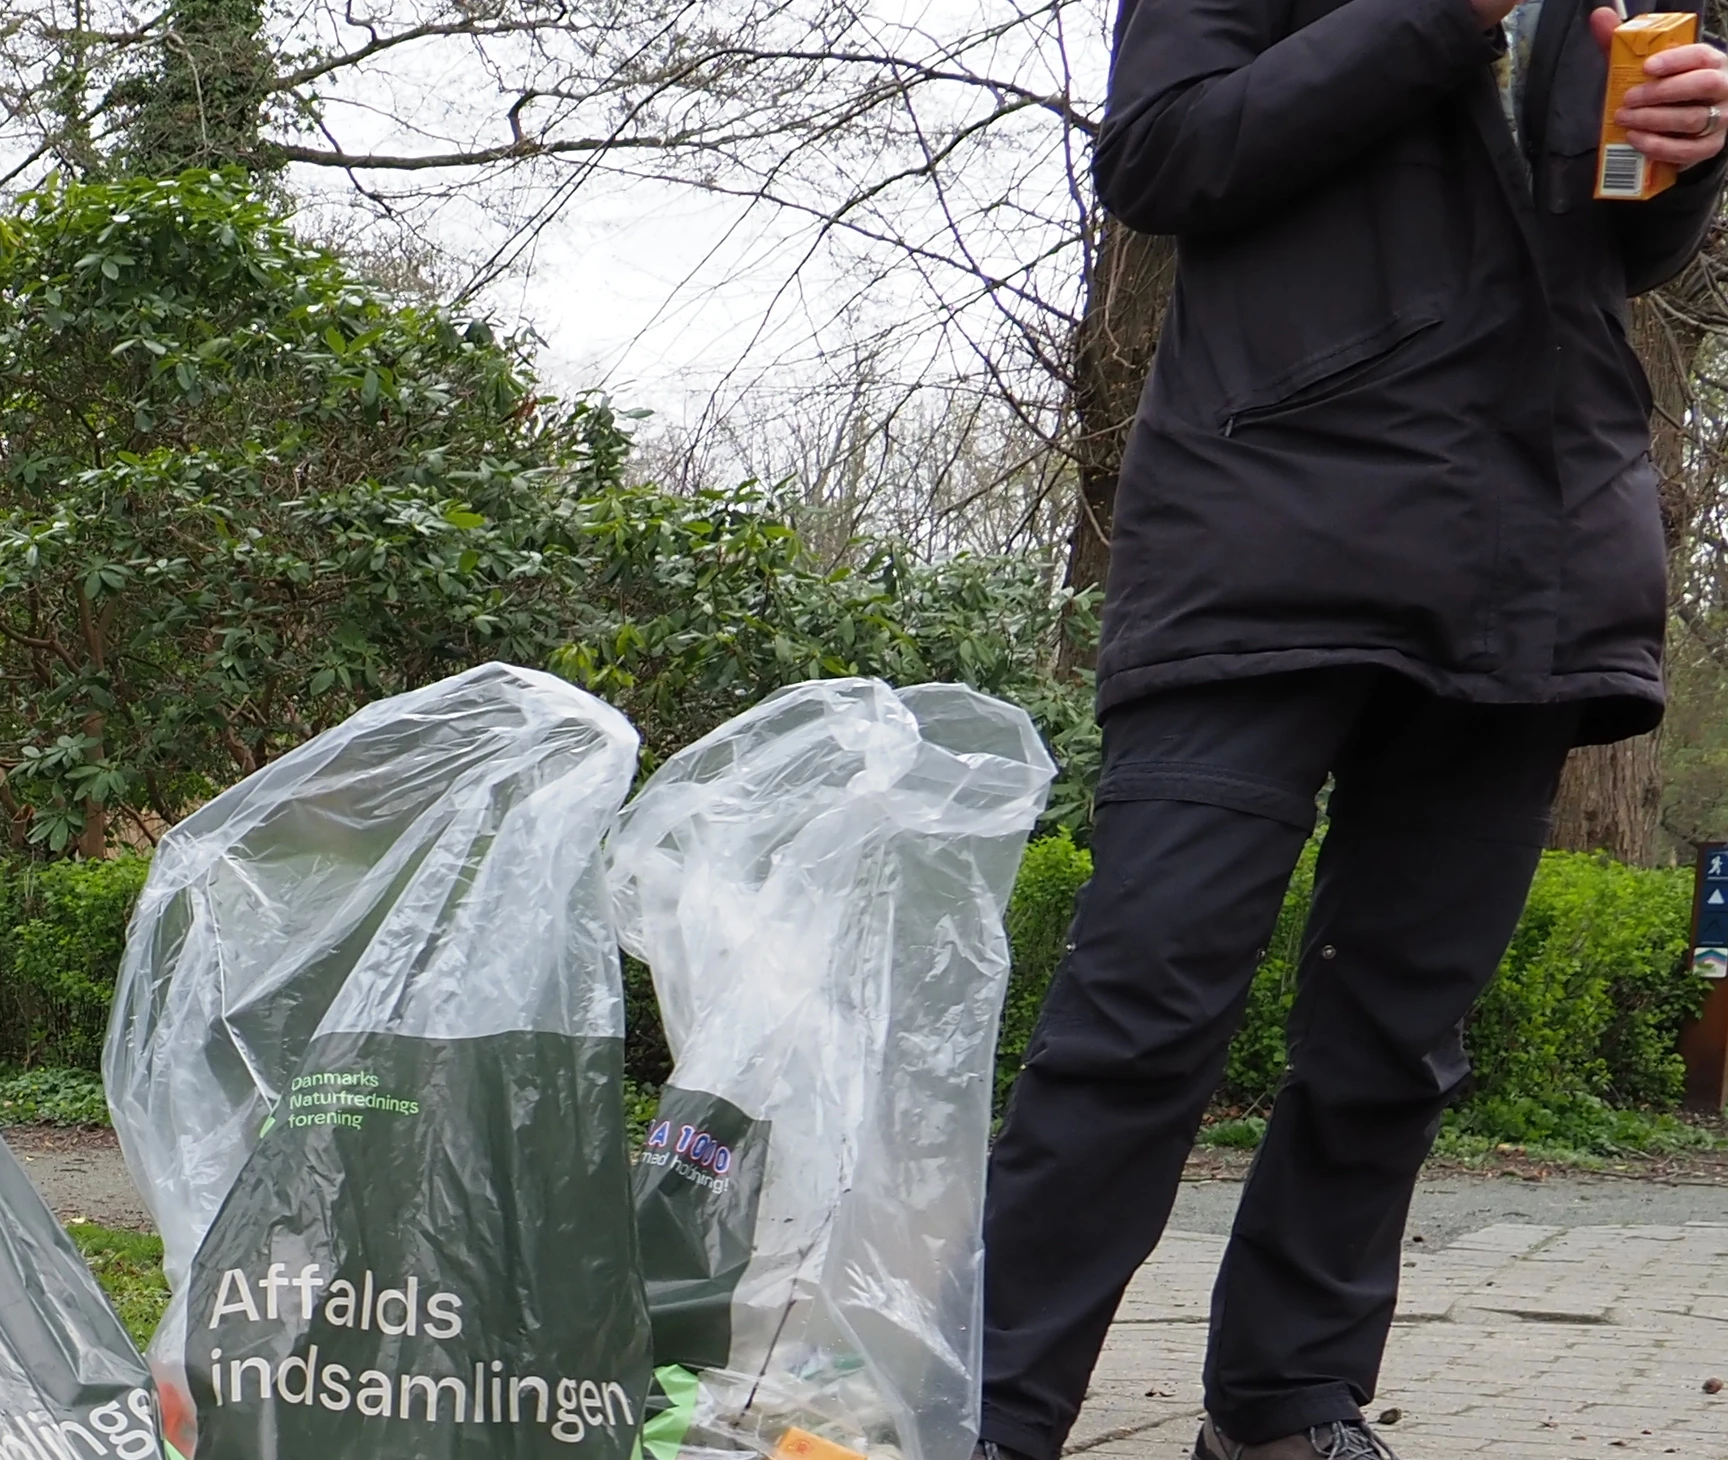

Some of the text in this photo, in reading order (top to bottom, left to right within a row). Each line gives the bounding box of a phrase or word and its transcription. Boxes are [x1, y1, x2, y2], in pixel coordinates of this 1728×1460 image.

[291, 1071, 379, 1091] Danmarks
[289, 1090, 420, 1115] Naturfrednings
[287, 1109, 363, 1130] forening
[209, 1263, 464, 1339] Affalds
[211, 1344, 634, 1443] indsamlingen
